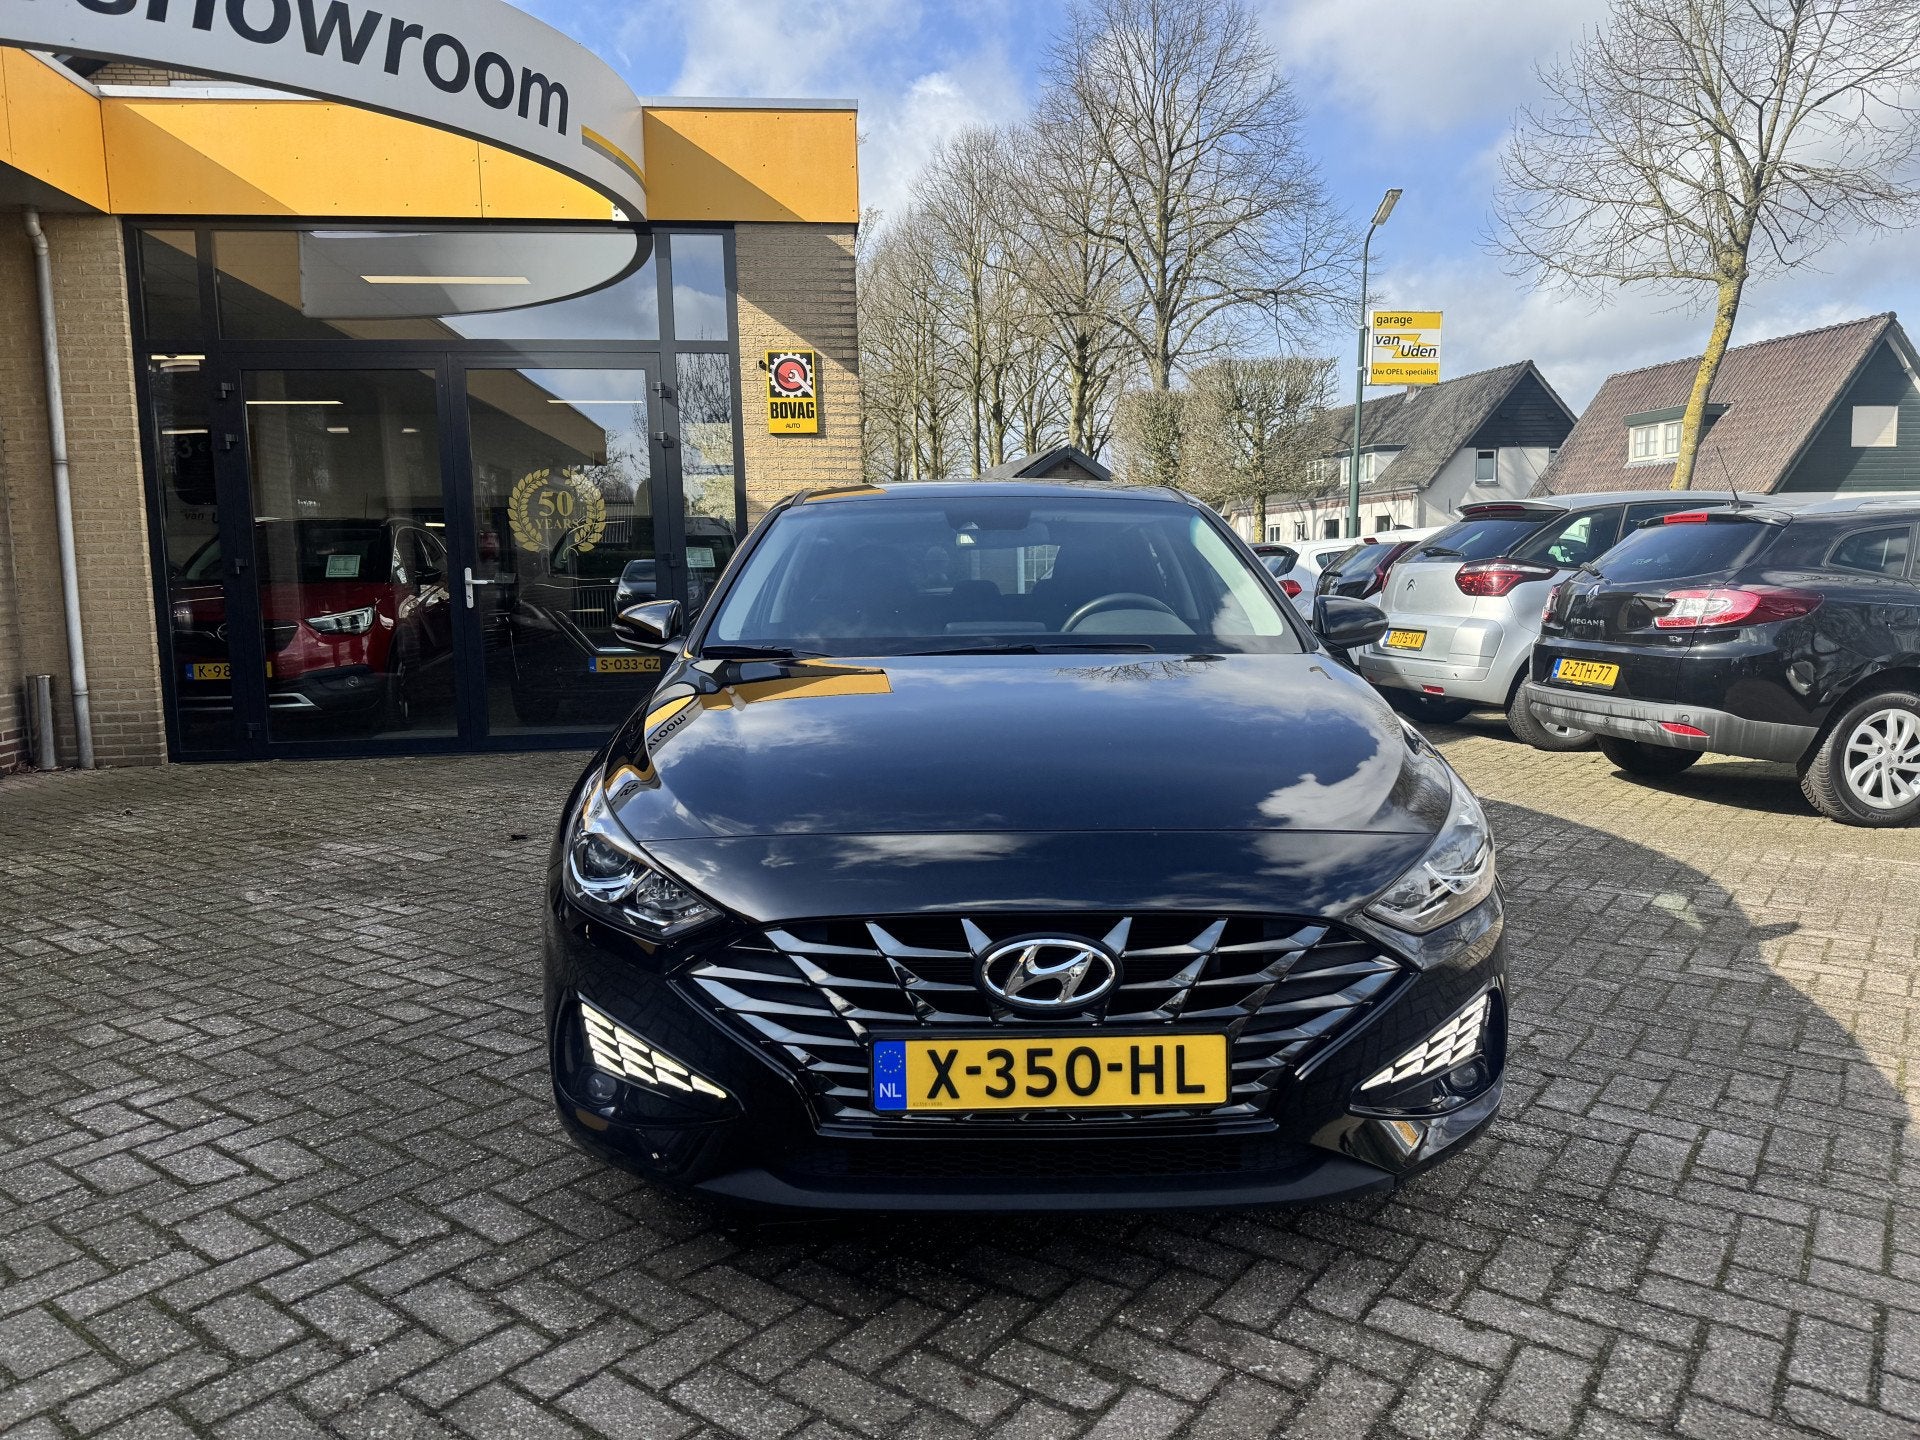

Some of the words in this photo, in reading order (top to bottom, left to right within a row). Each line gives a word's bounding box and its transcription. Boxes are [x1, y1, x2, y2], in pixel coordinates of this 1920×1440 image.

[76, 0, 570, 137] owroom
[1376, 316, 1413, 327] garage
[1375, 335, 1400, 346] van
[1401, 345, 1437, 357] Uden
[1405, 368, 1437, 377] specialist
[769, 401, 815, 419] BOVAG
[538, 490, 574, 517] 50
[535, 519, 579, 530] YEARS
[600, 658, 660, 670] S-033-GZ
[1561, 661, 1613, 681] 2-ZTH-77
[926, 1045, 1206, 1100] X-350-HL
[879, 1082, 902, 1099] NL
